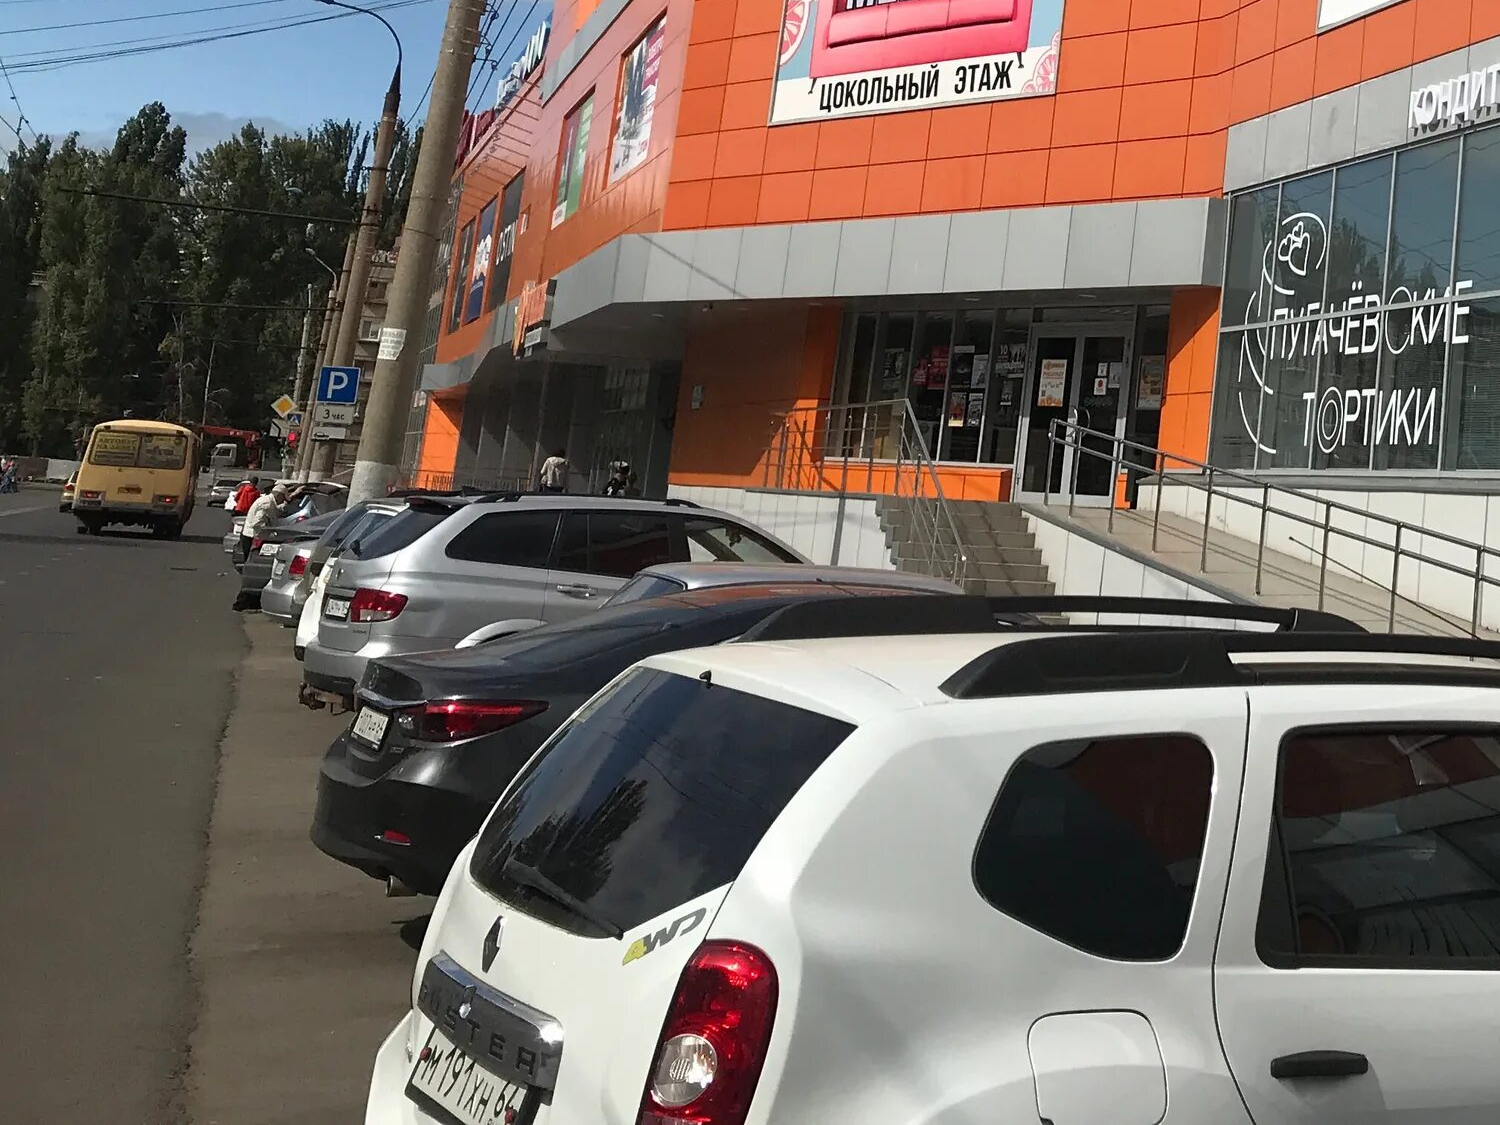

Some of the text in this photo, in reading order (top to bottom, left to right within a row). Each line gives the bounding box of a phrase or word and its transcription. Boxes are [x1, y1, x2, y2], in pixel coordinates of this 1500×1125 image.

[819, 59, 1014, 113] ЦОКОЛЬНЫЙ ЭТАЖ
[327, 371, 348, 399] P
[323, 409, 330, 419] 3
[1302, 386, 1437, 454] ТОРТИКИ
[622, 907, 707, 966] 4WD
